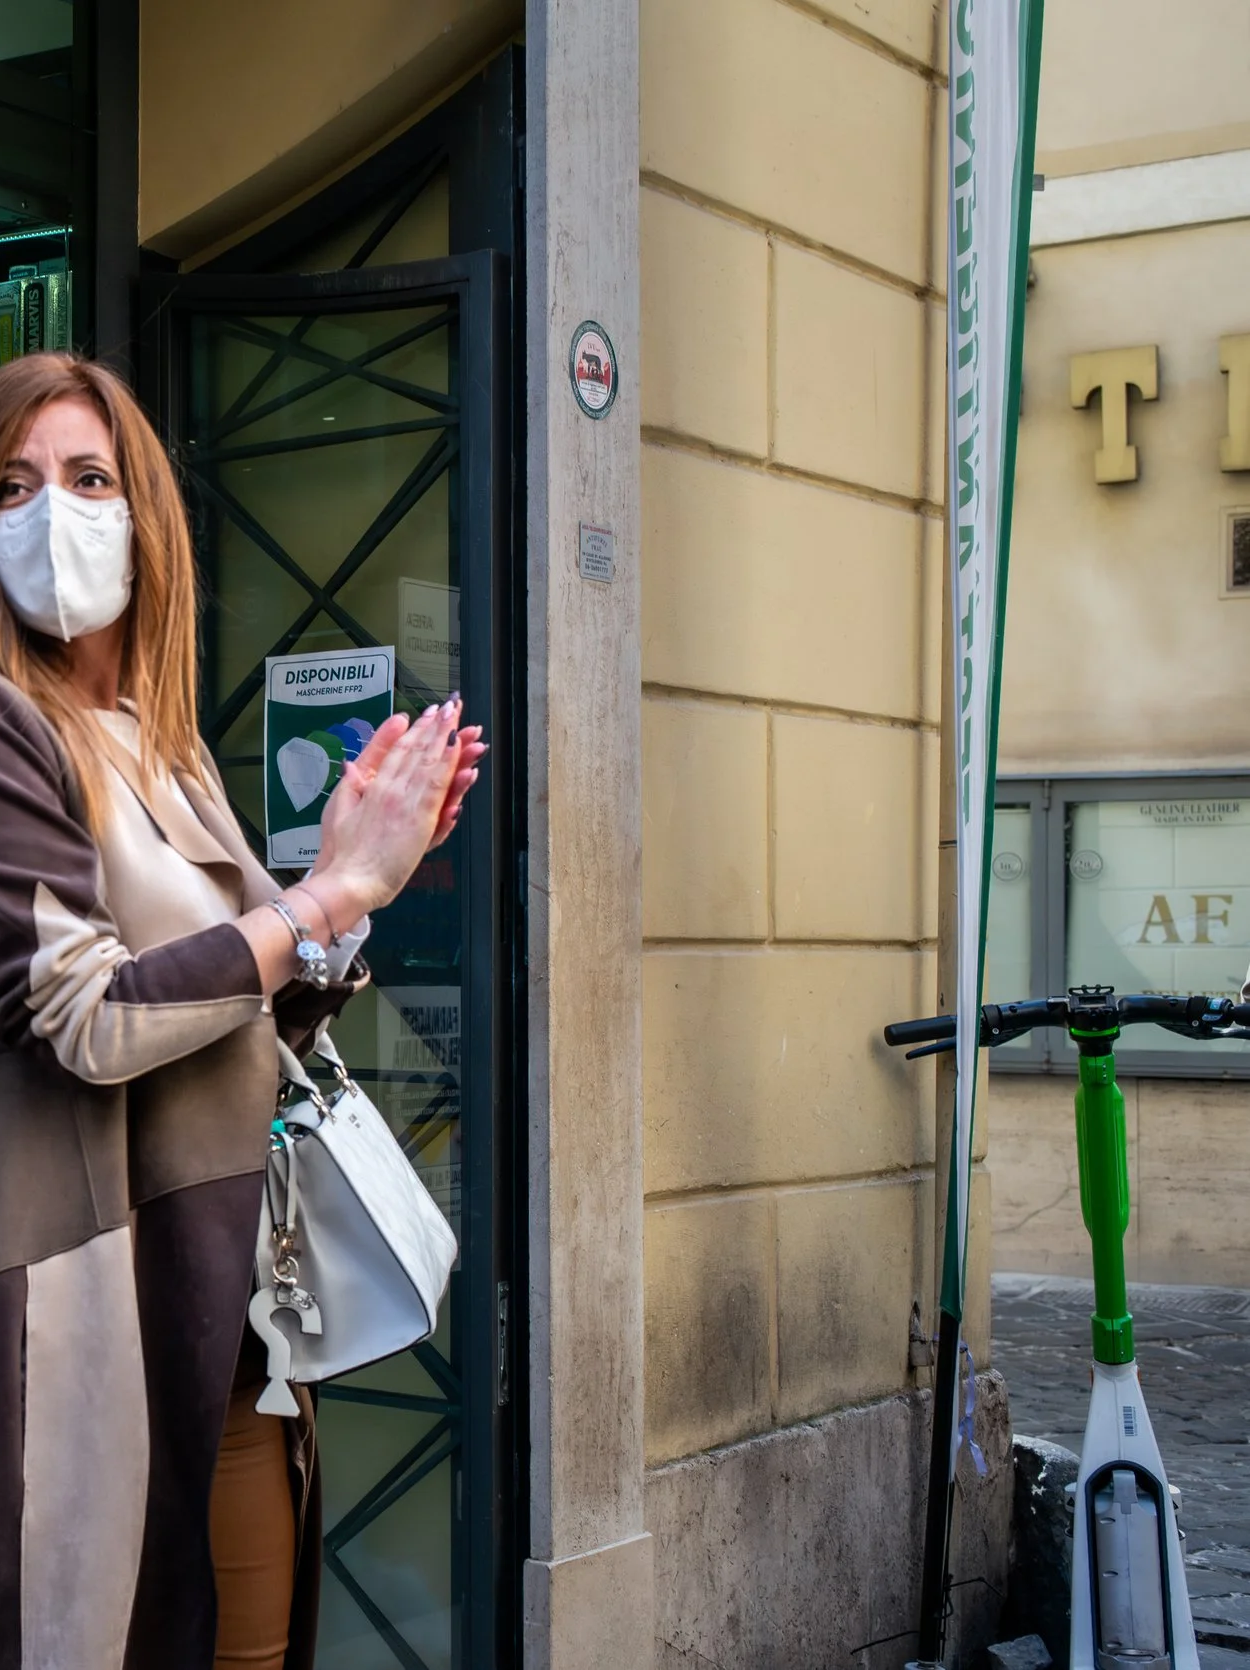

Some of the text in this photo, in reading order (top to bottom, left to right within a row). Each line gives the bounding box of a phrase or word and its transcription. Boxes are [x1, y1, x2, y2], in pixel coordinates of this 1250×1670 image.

[285, 664, 375, 685] DISPONIBILI
[296, 685, 363, 697] MASCHERINE FFP2
